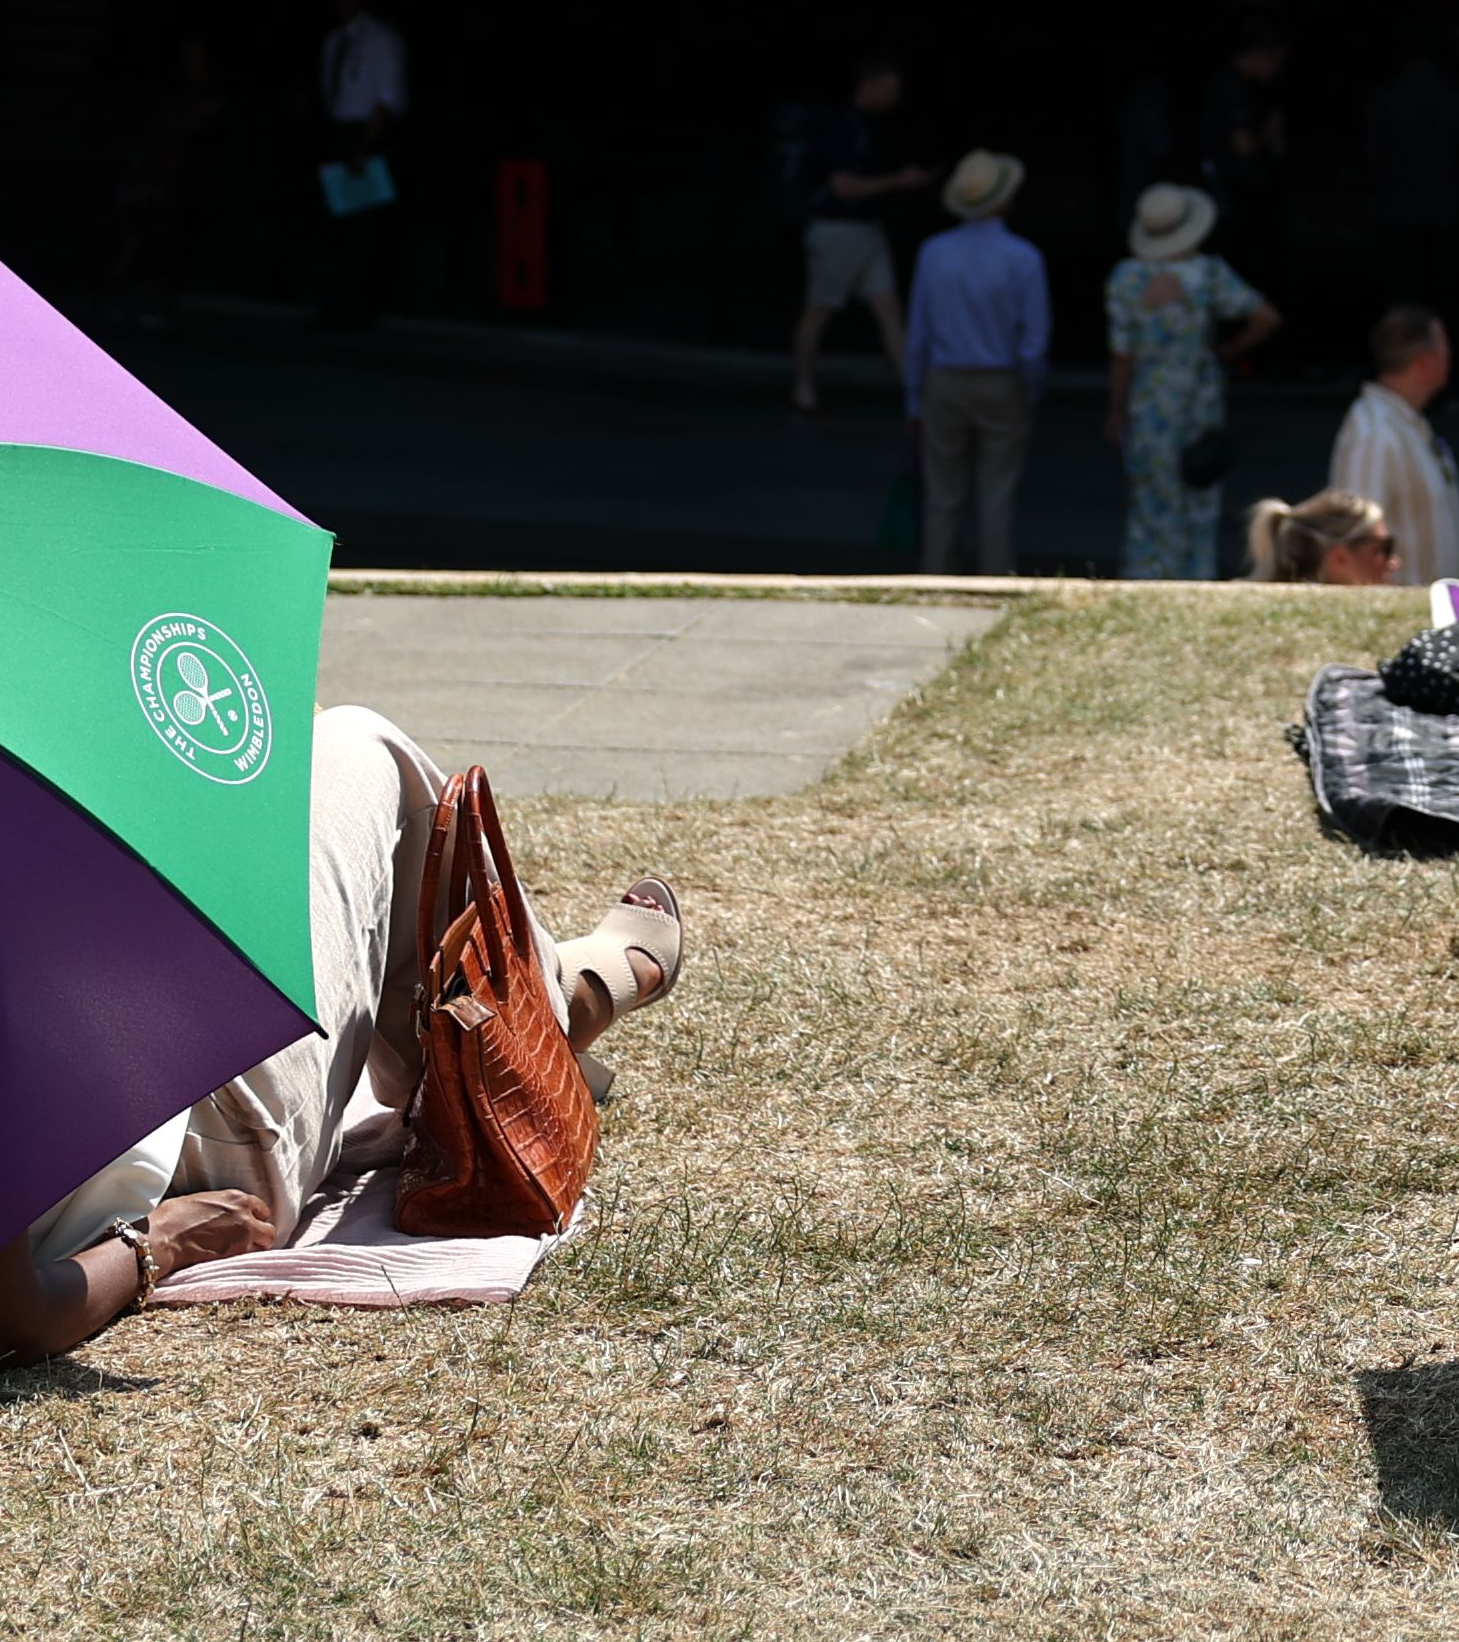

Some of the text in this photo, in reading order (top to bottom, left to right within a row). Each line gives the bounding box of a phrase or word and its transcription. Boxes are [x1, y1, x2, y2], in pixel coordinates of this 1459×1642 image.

[140, 622, 207, 760] THE CHAMPIONSHIPS
[233, 673, 265, 772] WIMBLEDON
